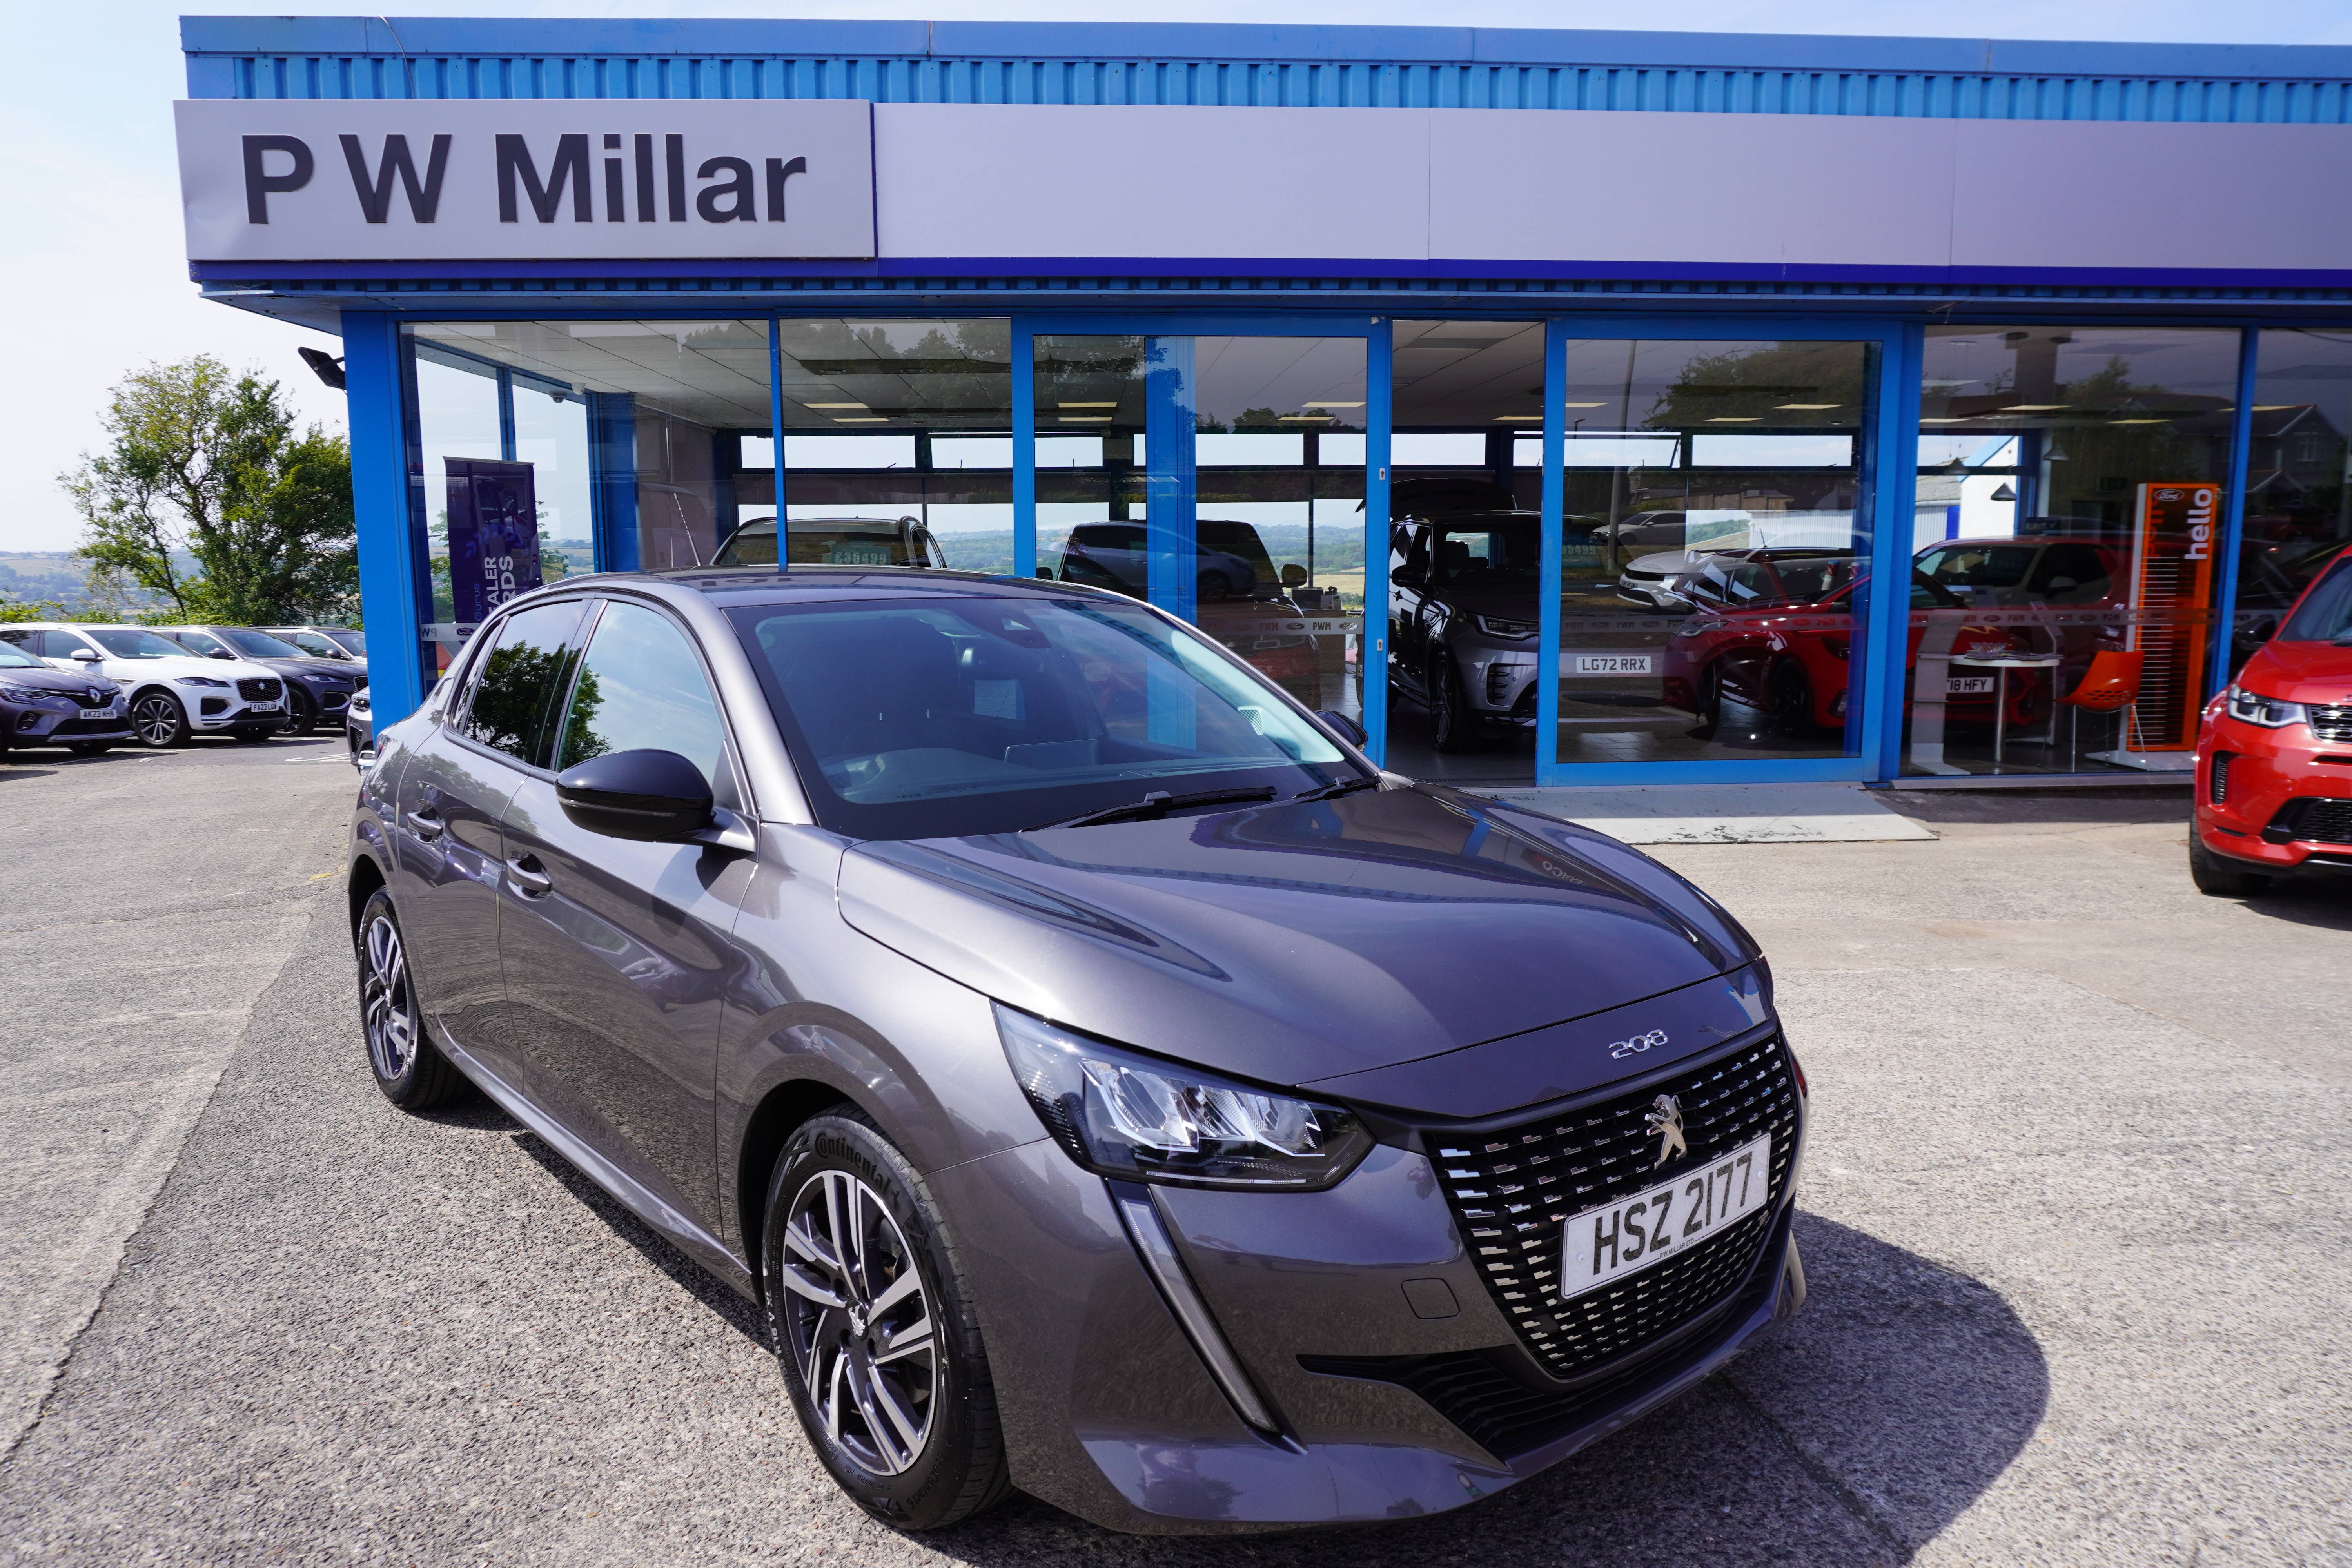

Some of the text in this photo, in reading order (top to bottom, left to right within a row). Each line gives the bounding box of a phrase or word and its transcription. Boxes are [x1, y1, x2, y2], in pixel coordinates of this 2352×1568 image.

[242, 134, 806, 225] P W Millar
[2159, 490, 2180, 500] Ford
[2184, 488, 2213, 559] hello
[835, 552, 887, 564] £35499
[2007, 614, 2025, 622] PWM
[1259, 622, 1278, 631] PWM
[1312, 622, 1331, 630] PWM
[1582, 658, 1646, 671] LG72 RRX
[1964, 679, 1987, 691] HFY
[1608, 1029, 1668, 1060] 208
[815, 1132, 892, 1195] Continental
[1593, 1151, 1753, 1276] HSZ 2177
[1686, 1238, 1694, 1247] LTD
[766, 1289, 773, 1307] XL
[768, 1311, 775, 1322] V
[771, 1327, 779, 1342] 16
[775, 1344, 782, 1354] R
